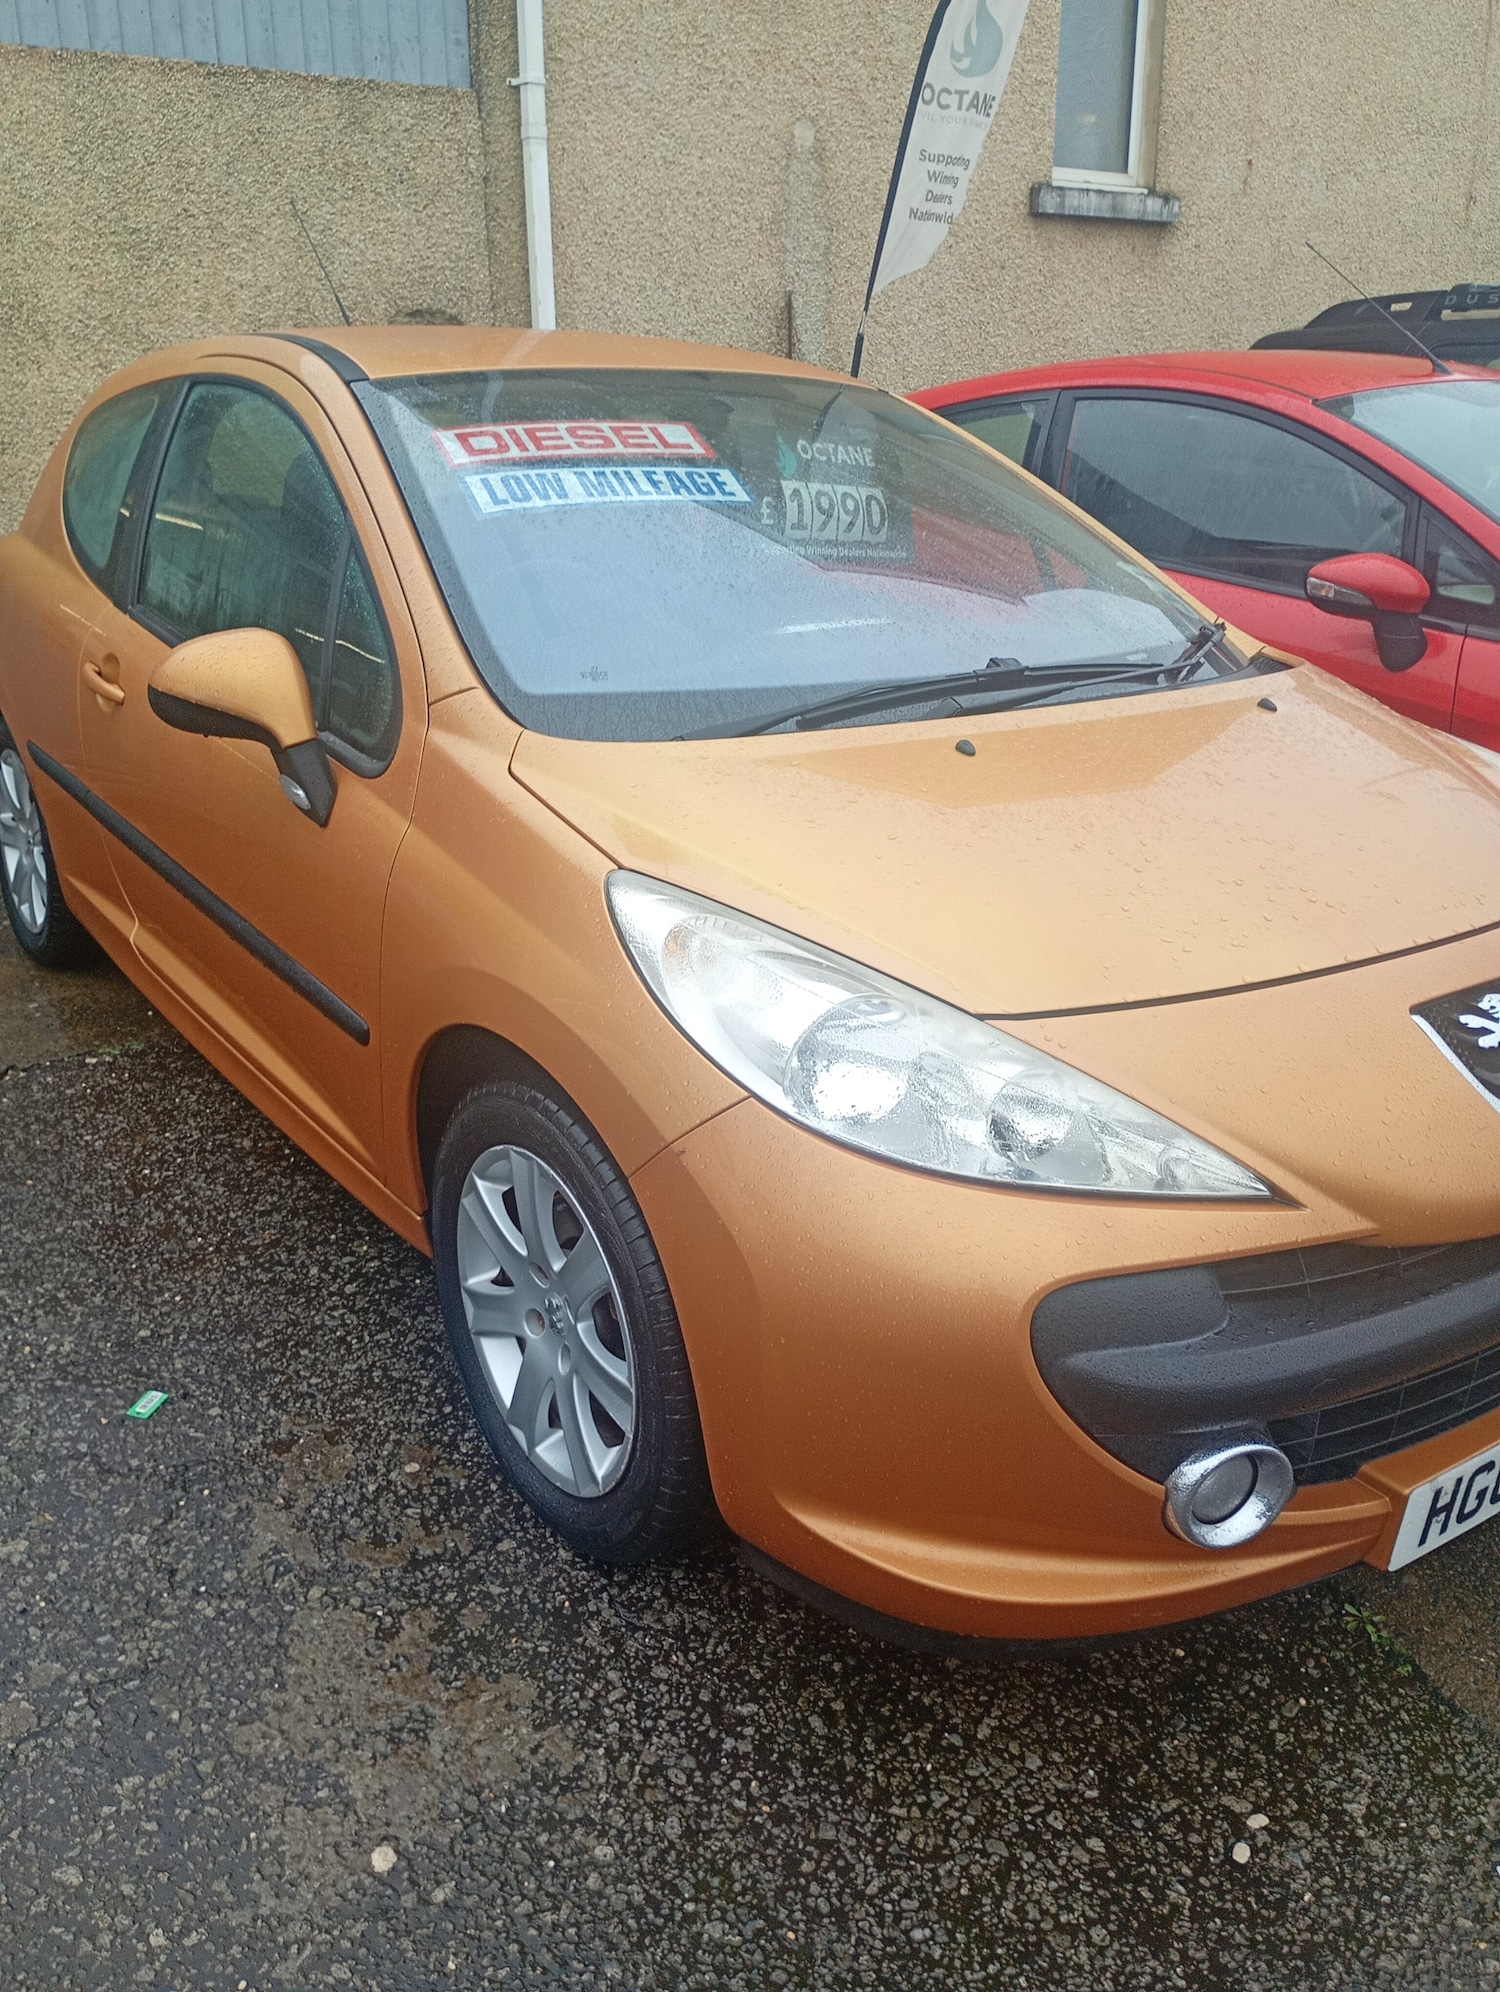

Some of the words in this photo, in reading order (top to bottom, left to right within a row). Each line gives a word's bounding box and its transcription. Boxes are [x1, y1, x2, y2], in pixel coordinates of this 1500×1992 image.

[921, 82, 996, 118] OCTANE
[454, 425, 693, 456] DIESEL
[796, 439, 876, 467] OCTANE
[480, 472, 568, 506] LOW
[574, 469, 736, 499] MILEAGE
